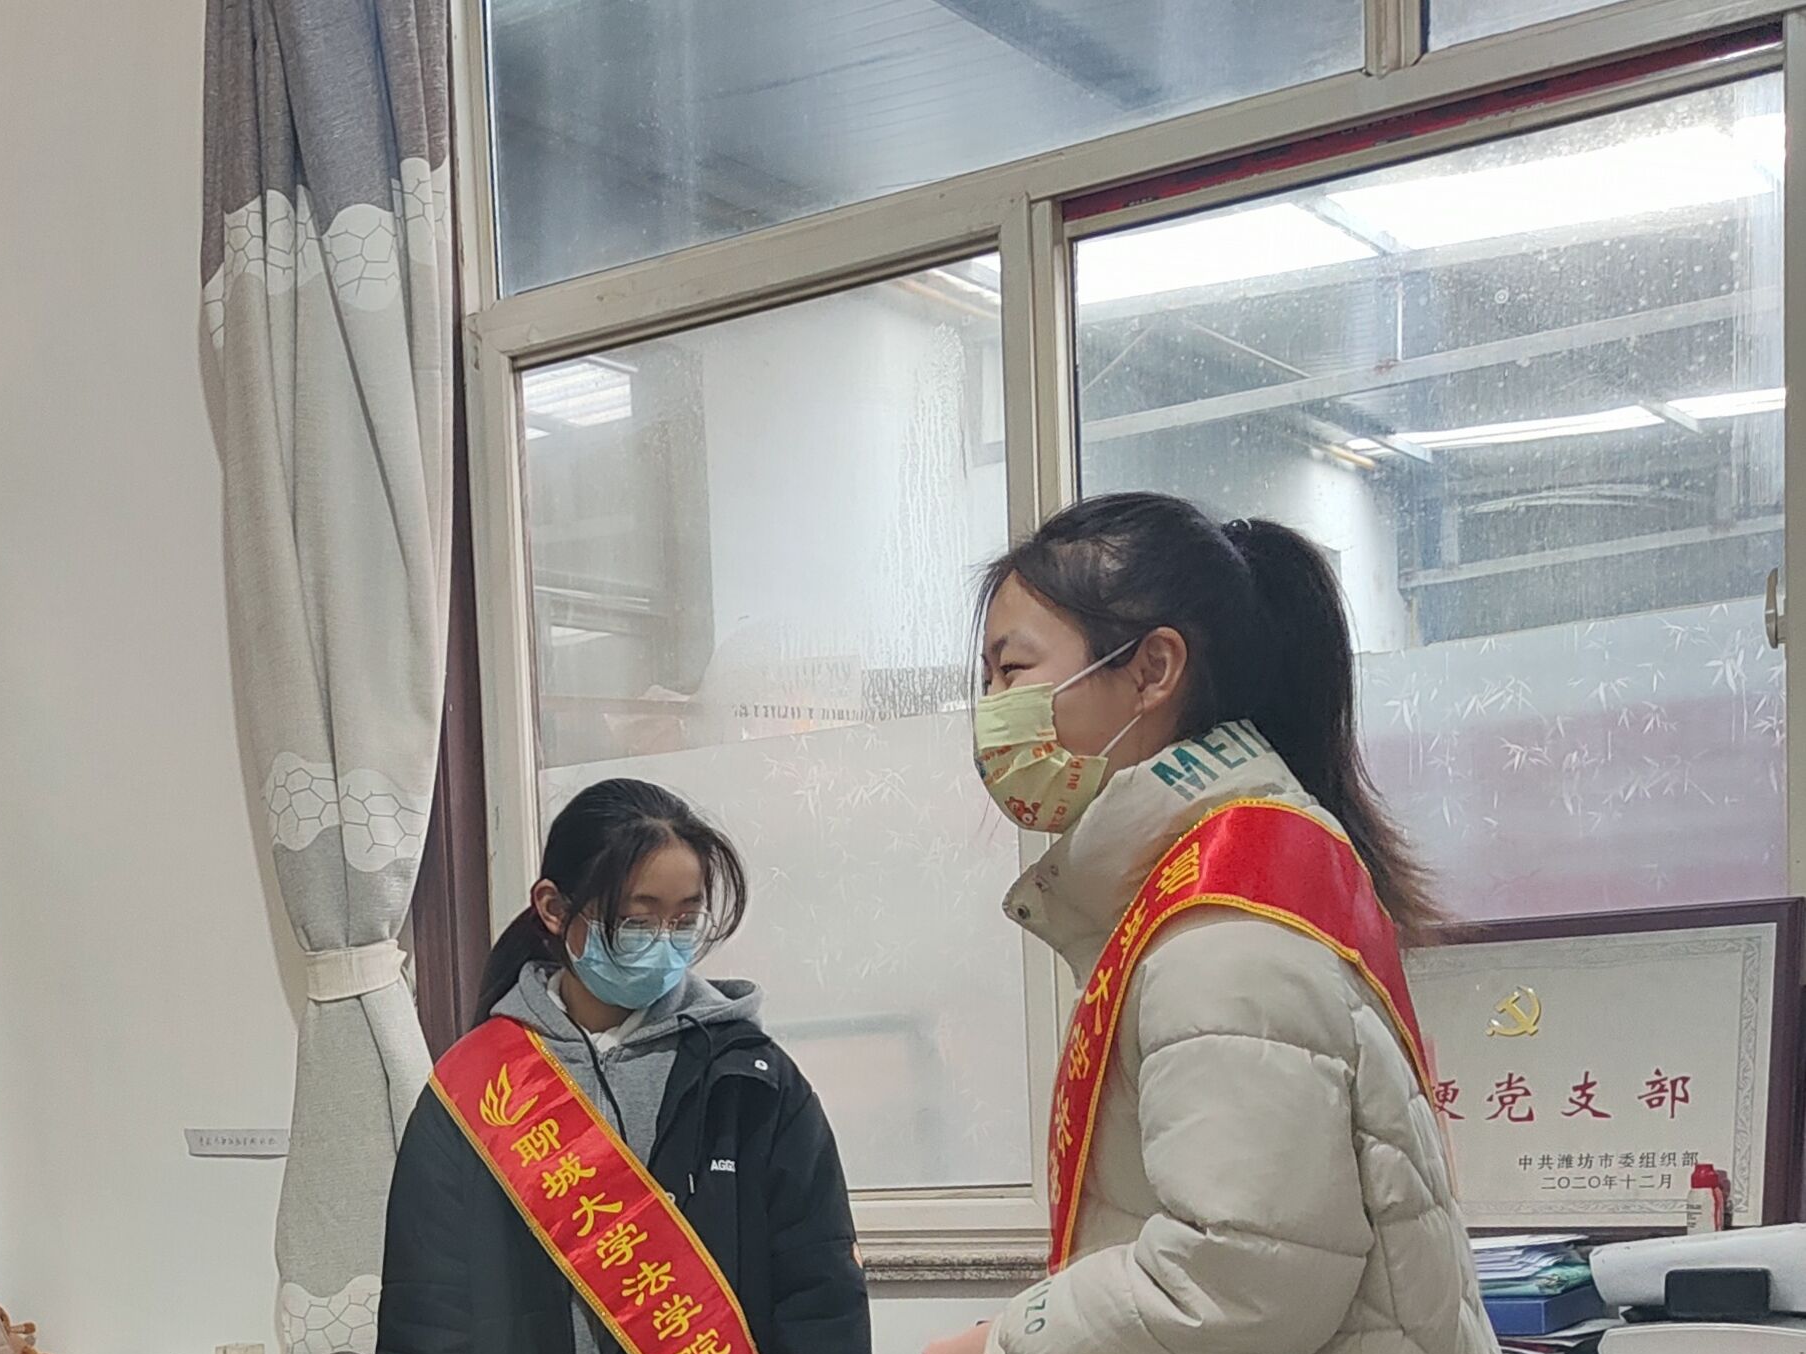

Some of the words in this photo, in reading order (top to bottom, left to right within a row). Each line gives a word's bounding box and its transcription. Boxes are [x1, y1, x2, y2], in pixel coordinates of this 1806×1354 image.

[1518, 1151, 1699, 1171] 中共潍坊市委组织部
